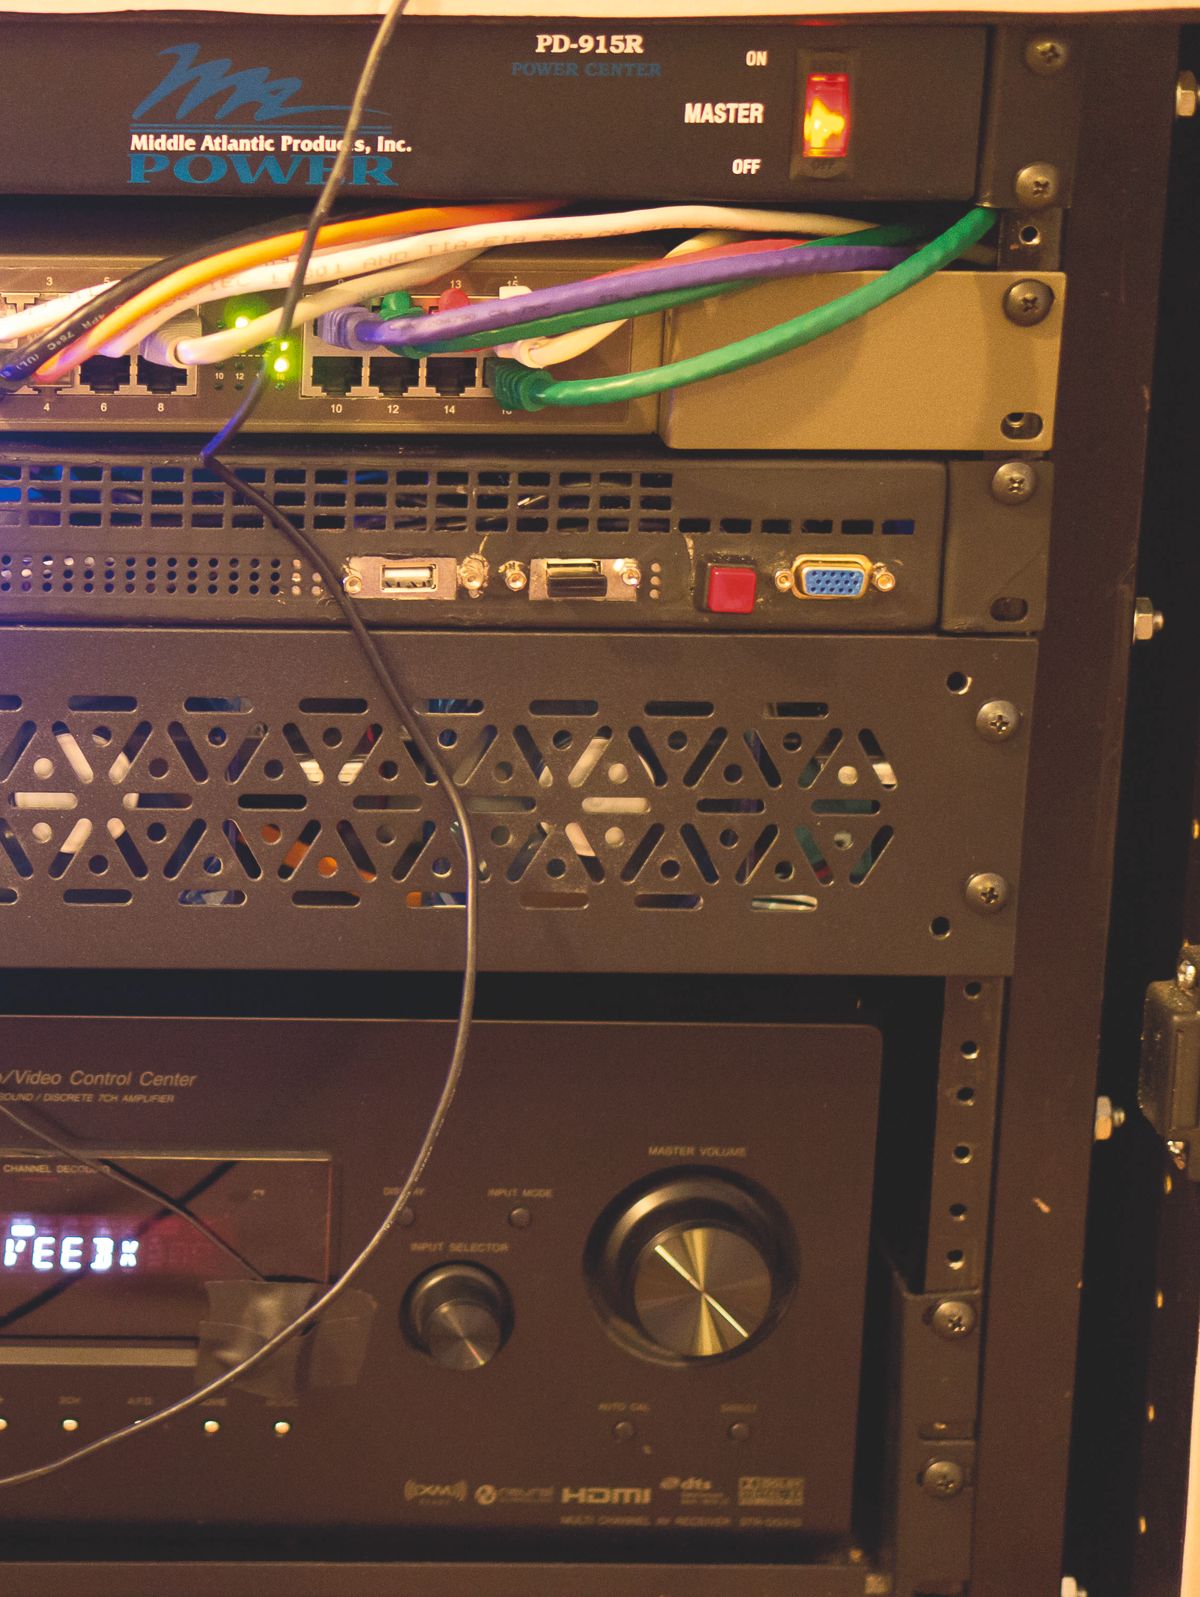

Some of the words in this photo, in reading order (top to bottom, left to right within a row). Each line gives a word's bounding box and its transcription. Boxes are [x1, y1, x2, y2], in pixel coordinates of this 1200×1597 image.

[535, 35, 644, 53] PD-915R
[746, 51, 767, 66] ON
[511, 62, 578, 77] POWER
[585, 62, 662, 77] CENTER
[684, 103, 764, 123] MASTER
[130, 134, 196, 152] Middle
[201, 135, 275, 152] Atlantic
[281, 135, 371, 154] Producs,
[377, 136, 412, 153] Inc.
[127, 154, 399, 186] POWER
[732, 158, 762, 174] OFF
[46, 277, 53, 286] 3
[450, 280, 462, 289] 13
[43, 403, 50, 412] 4
[100, 403, 107, 412] 6
[158, 403, 165, 412] 8
[330, 405, 343, 413] 10
[387, 405, 399, 414] 12
[444, 405, 456, 414] 14
[70, 1070, 132, 1086] Control
[140, 1071, 198, 1087] Center
[648, 1146, 695, 1157] MASTER
[698, 1146, 746, 1157] VOLUME
[3, 1164, 52, 1173] CHANNEL
[561, 1487, 651, 1504] HDMI
